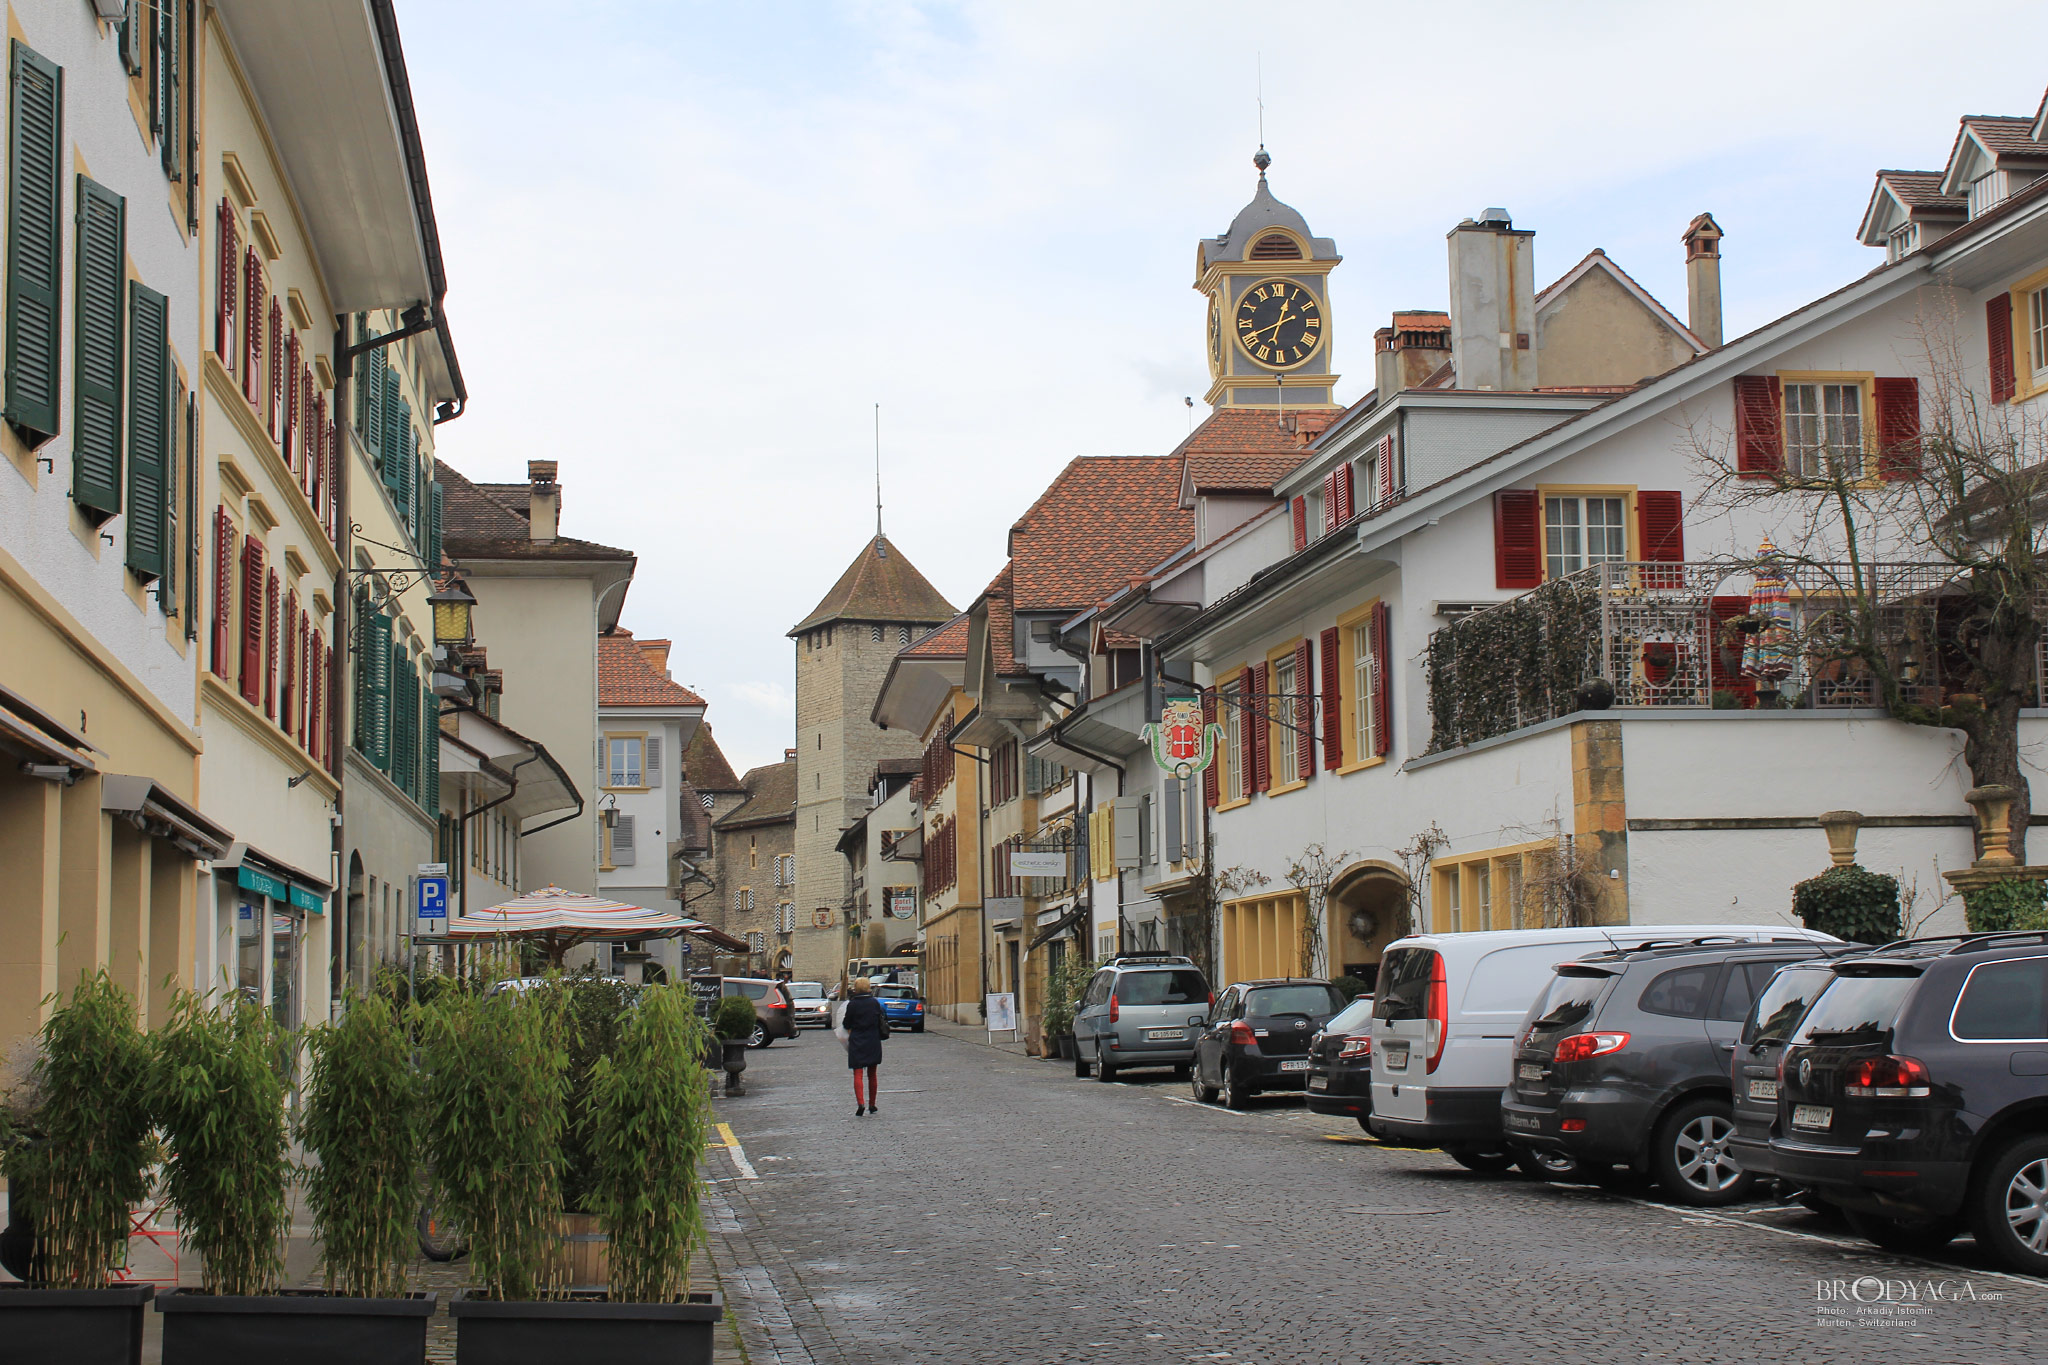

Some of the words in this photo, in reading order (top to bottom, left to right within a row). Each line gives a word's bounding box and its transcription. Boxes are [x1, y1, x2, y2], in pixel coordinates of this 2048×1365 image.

[1254, 287, 1269, 303] XI
[1271, 284, 1284, 297] XII
[1290, 288, 1300, 301] I
[1242, 300, 1257, 313] X
[1300, 300, 1315, 312] II
[1238, 318, 1253, 329] IX
[1306, 318, 1319, 328] III
[1256, 344, 1270, 360] VII
[1276, 350, 1286, 363] VI
[1292, 345, 1303, 359] V
[422, 882, 439, 907] P
